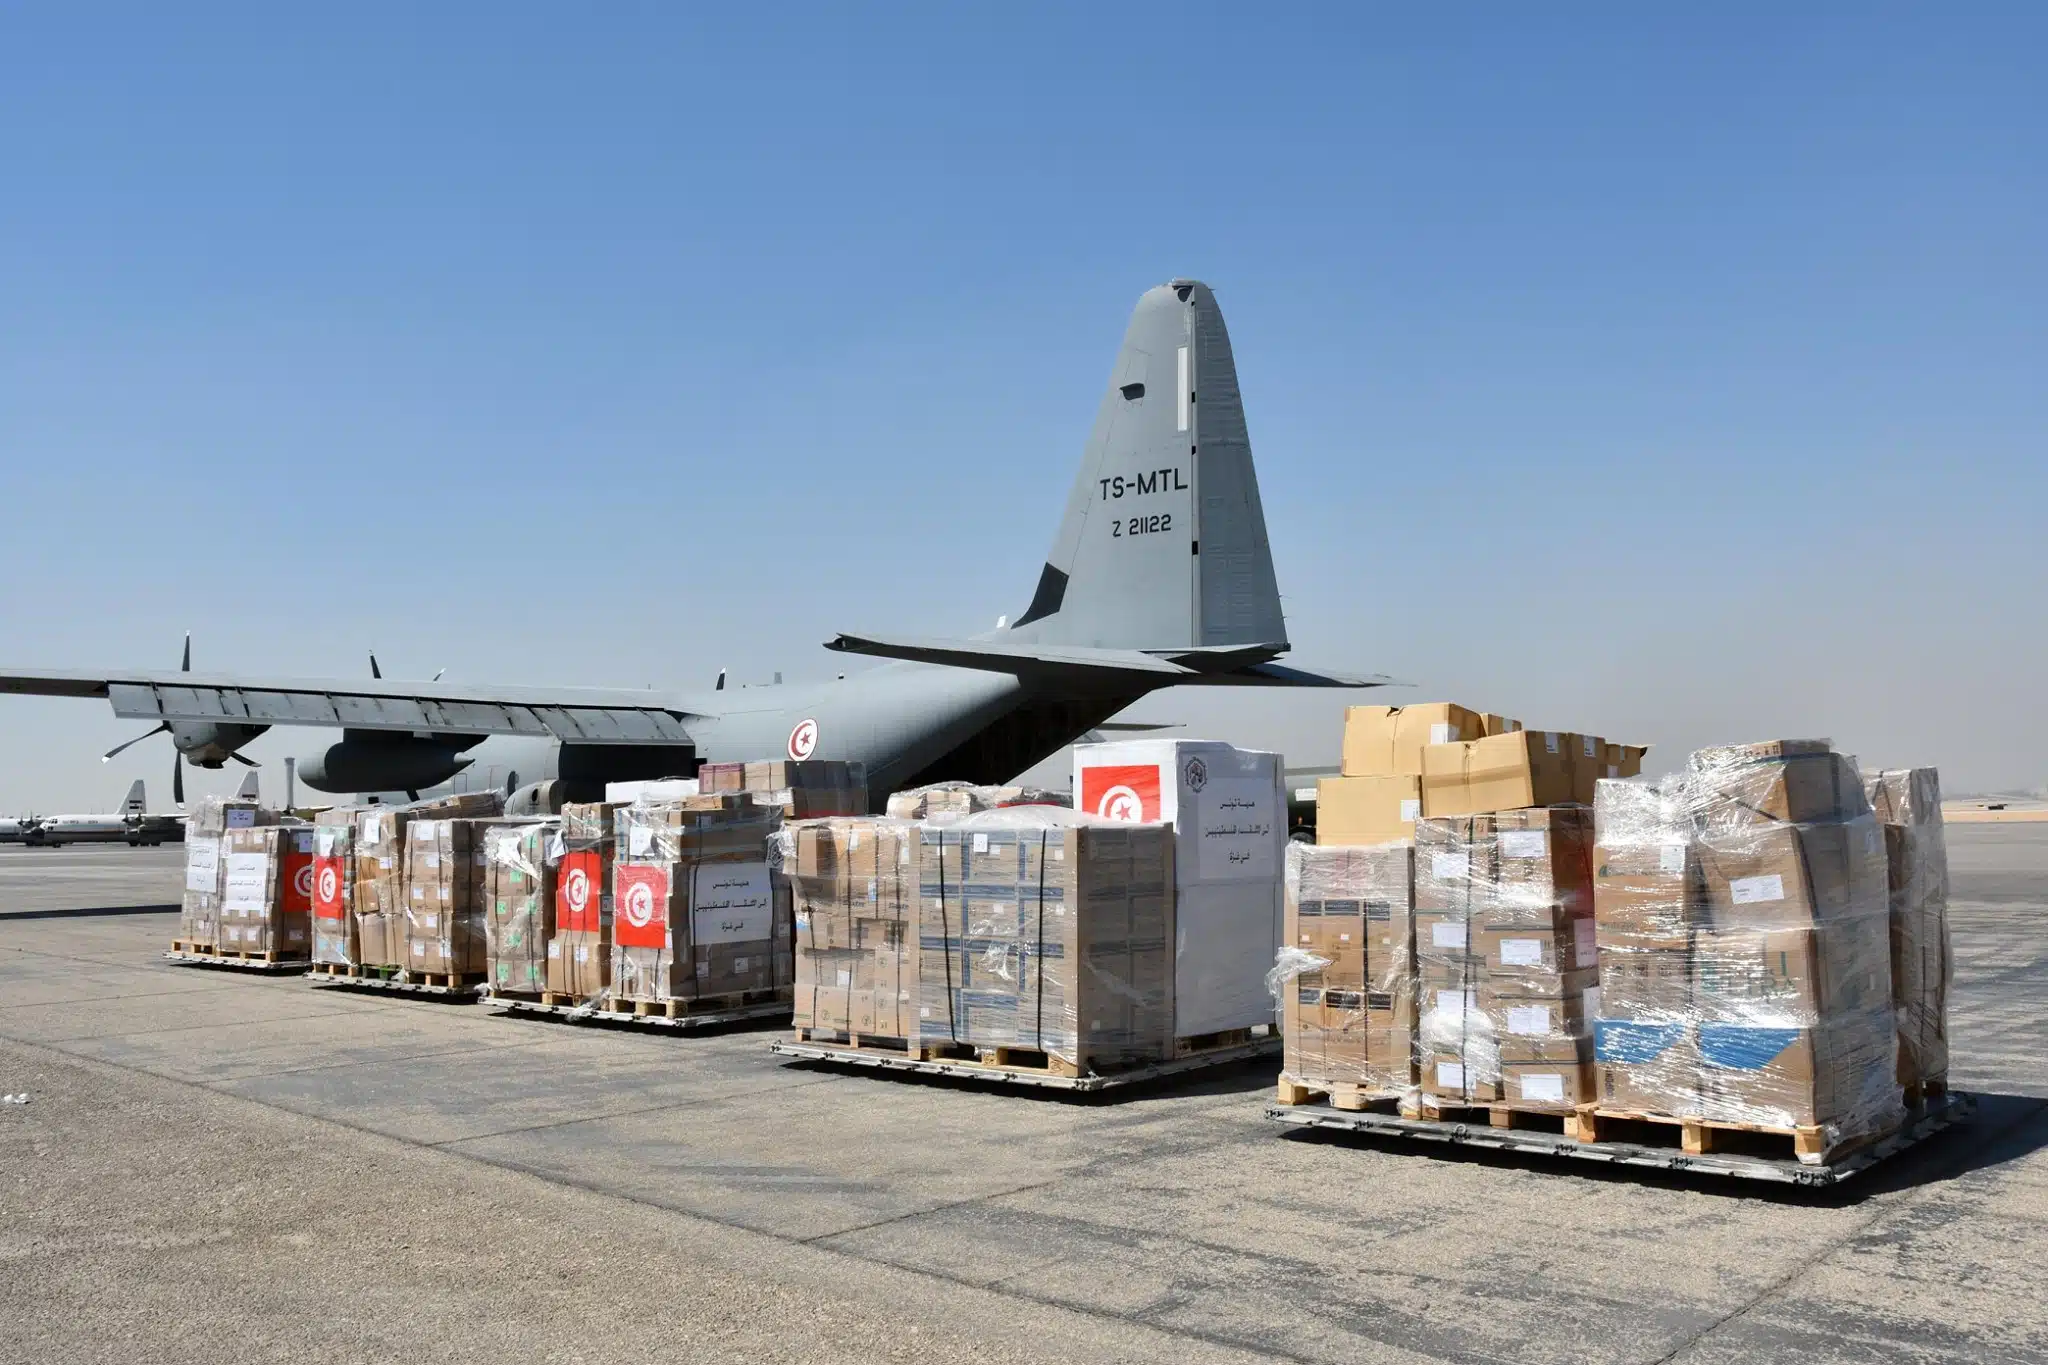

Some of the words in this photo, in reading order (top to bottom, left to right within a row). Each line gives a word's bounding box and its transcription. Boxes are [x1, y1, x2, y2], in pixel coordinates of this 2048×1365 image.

[1100, 468, 1188, 500] TS-MTL
[1112, 521, 1121, 537] Z
[1129, 514, 1172, 535] 21122
